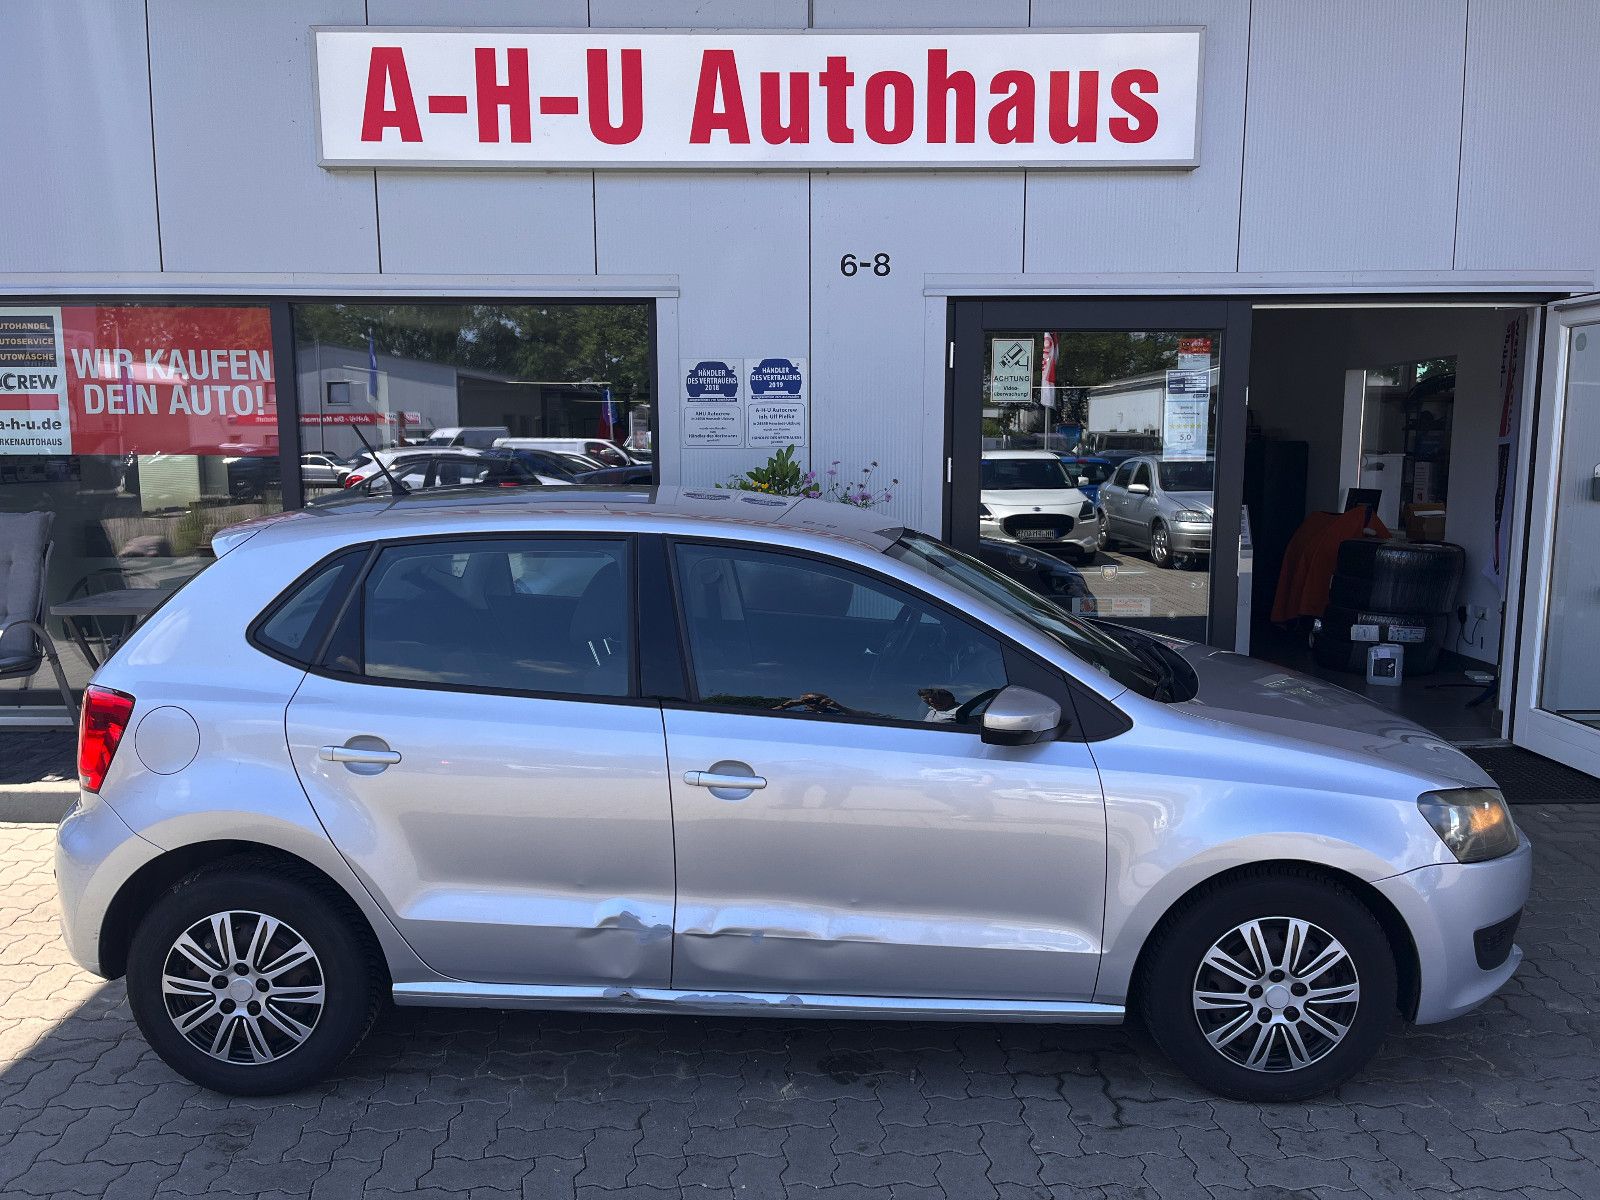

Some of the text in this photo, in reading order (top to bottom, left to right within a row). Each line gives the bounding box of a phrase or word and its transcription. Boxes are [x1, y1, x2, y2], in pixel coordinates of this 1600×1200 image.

[361, 47, 1159, 145] A-H-U Autohaus
[841, 253, 890, 277] 6-8
[71, 348, 271, 380] WIR KAUFEN
[698, 368, 726, 377] HÄNDLER
[0, 373, 58, 391] CREW
[83, 384, 265, 416] DEIN AUTO!
